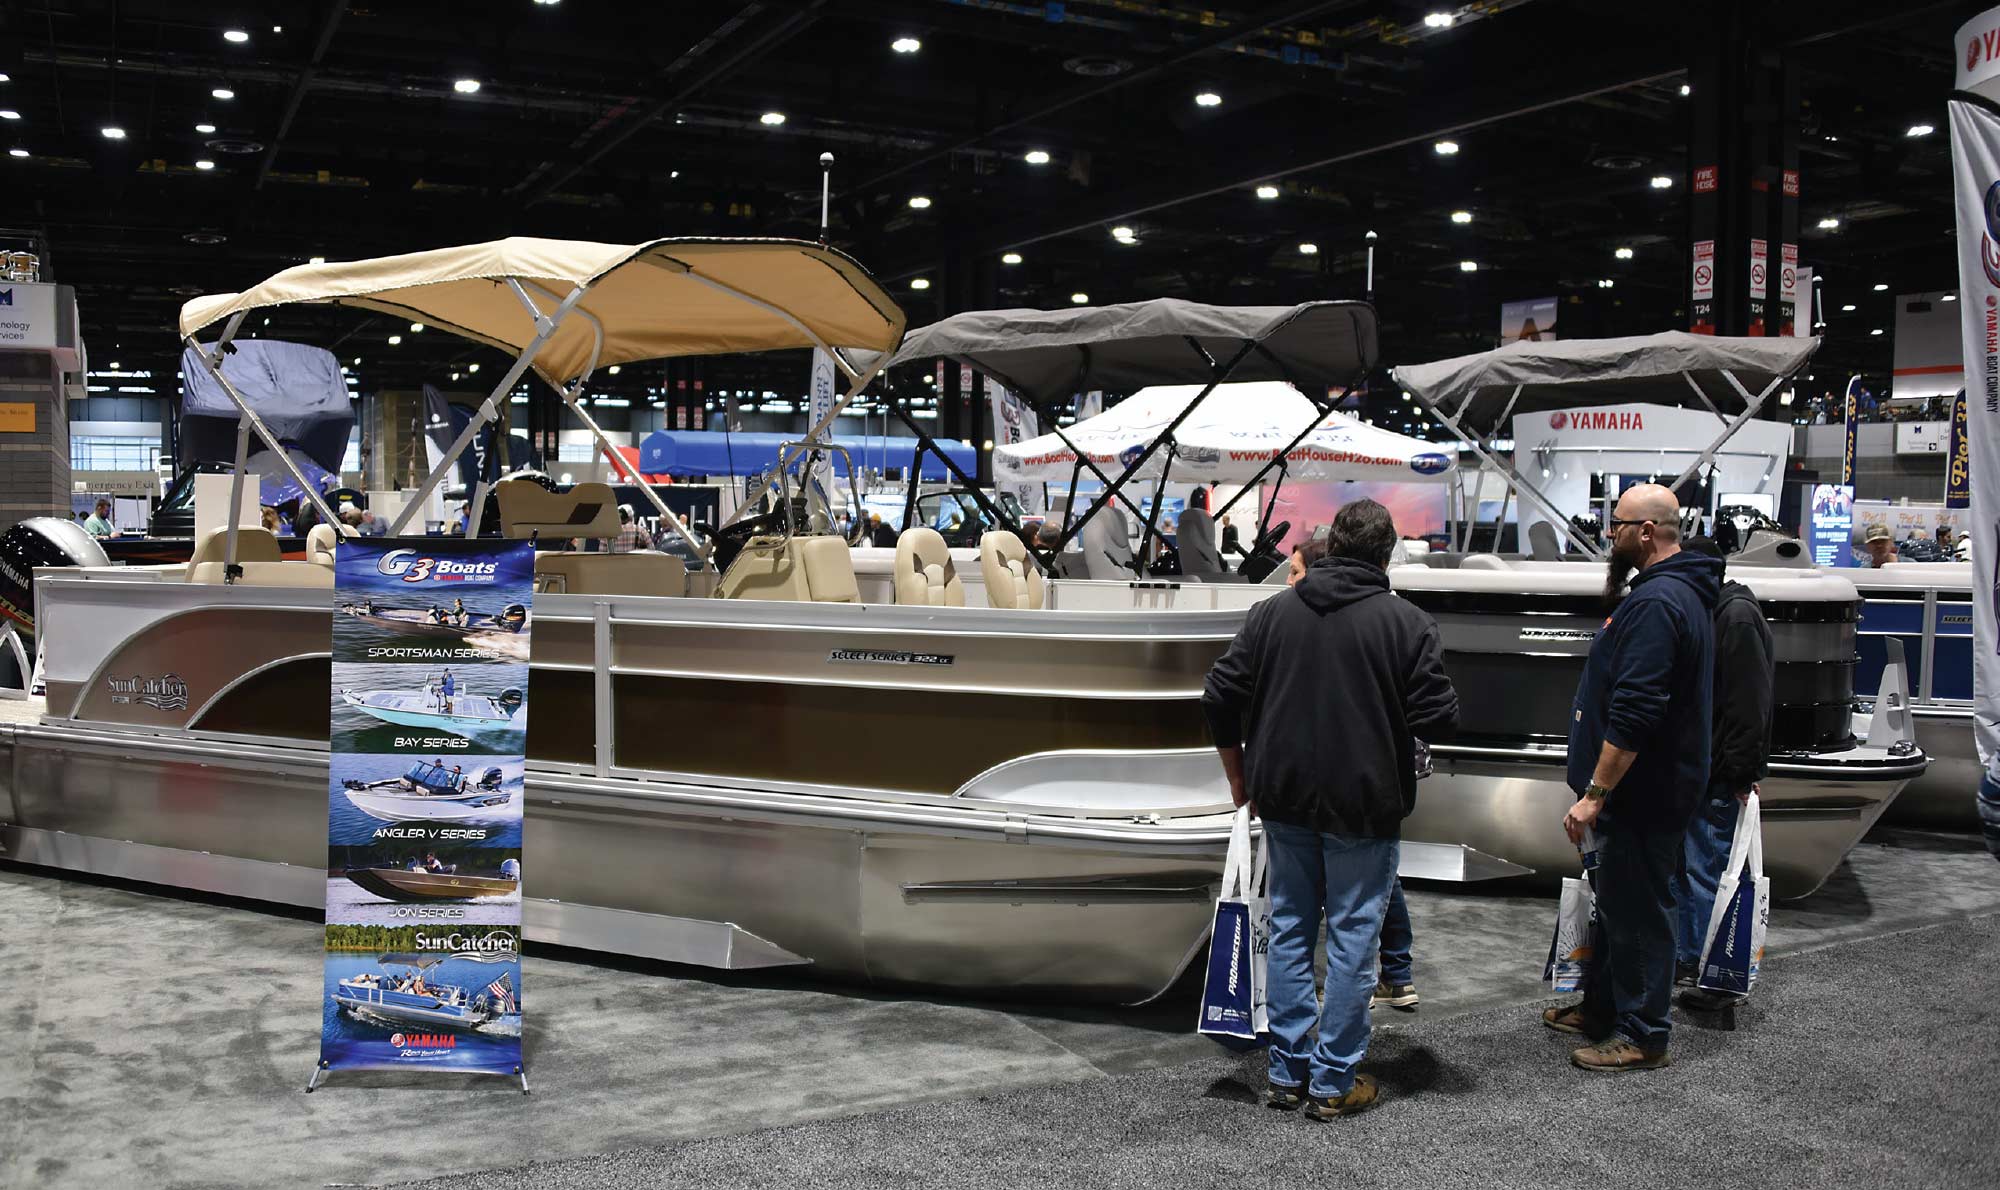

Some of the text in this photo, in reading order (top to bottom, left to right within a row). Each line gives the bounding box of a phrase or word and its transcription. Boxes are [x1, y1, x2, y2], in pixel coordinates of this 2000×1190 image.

[1697, 170, 1713, 180] FIRE
[1695, 304, 1710, 314] T24
[1751, 303, 1764, 313] T24
[1782, 307, 1793, 316] T24
[1986, 308, 1999, 413] YAMAHA BOAT COMPANY
[1570, 412, 1634, 430] YAMAHA
[1229, 447, 1402, 466] www.BatHouseH2o.com
[86, 480, 155, 492] mergency Exit
[377, 548, 496, 583] G3 Boats
[1, 560, 29, 590] YAMAHA
[368, 648, 500, 658] SPORTSMAN SERIES
[831, 651, 868, 660] SELECT
[394, 737, 470, 748] BAY SERIES
[372, 829, 487, 840] ANGLER V SERIES
[389, 908, 464, 918] JON SERIES
[415, 932, 515, 951] SunCatcher
[1228, 913, 1241, 997] PROGRESSIVE
[406, 1034, 456, 1048] YAMAHA
